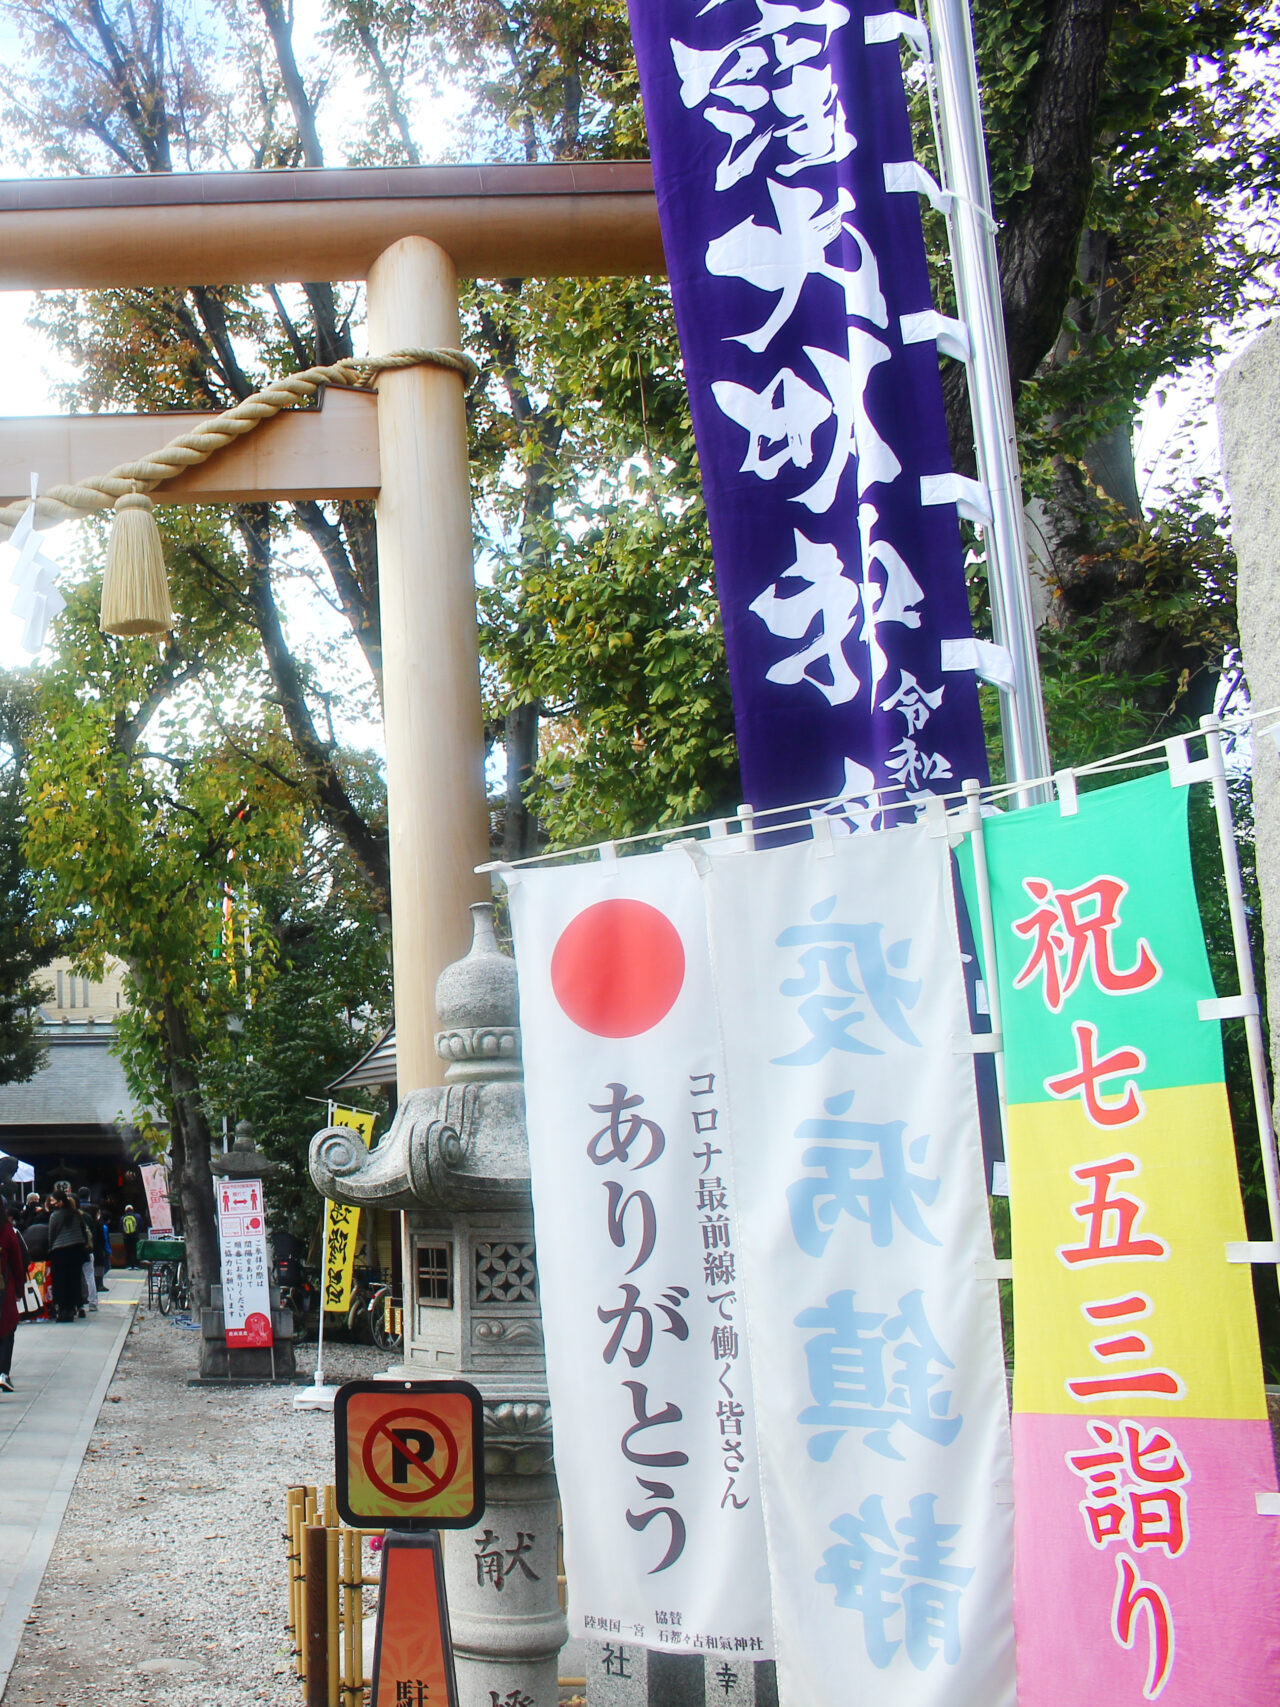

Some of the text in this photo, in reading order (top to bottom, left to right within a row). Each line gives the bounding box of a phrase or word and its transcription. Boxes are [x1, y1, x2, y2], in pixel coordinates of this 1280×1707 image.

[586, 1082, 690, 1574] ありがとう
[689, 1073, 750, 1510] コロナ最前線で働く皆さん
[1012, 875, 1191, 1699] 祝七五三詣り
[584, 1615, 646, 1638] 陸奥国一宮
[602, 1642, 632, 1679] 社
[716, 1663, 738, 1695] 幸
